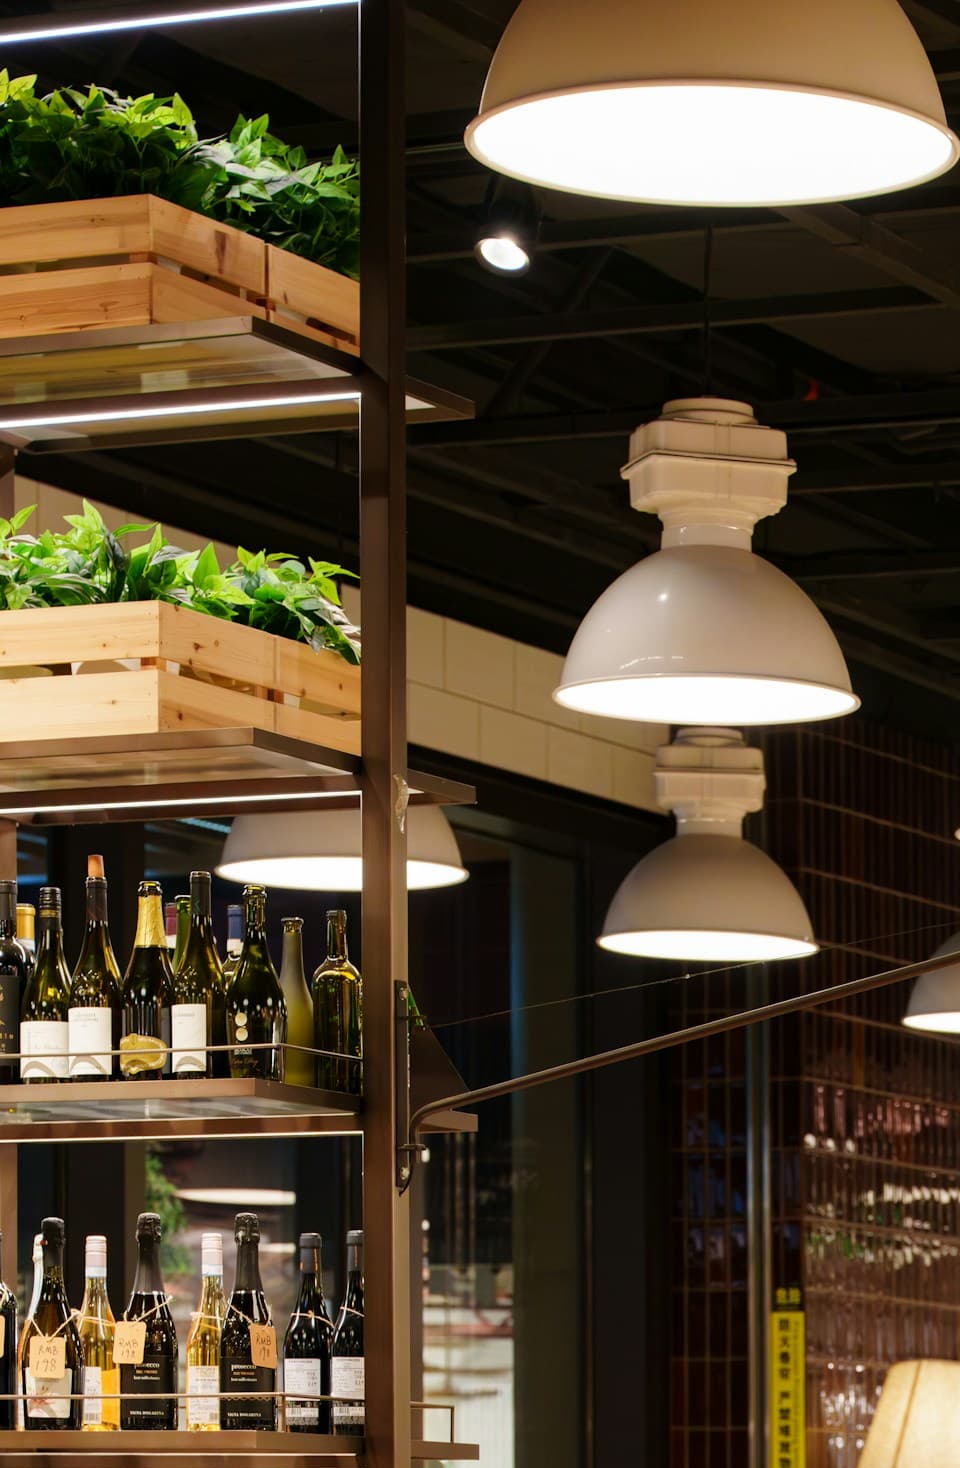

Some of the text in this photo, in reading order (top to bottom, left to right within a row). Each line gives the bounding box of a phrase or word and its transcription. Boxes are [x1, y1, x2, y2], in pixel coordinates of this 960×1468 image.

[256, 1333, 272, 1346] RMB
[38, 1345, 57, 1355] RMB
[36, 1359, 57, 1373] 198
